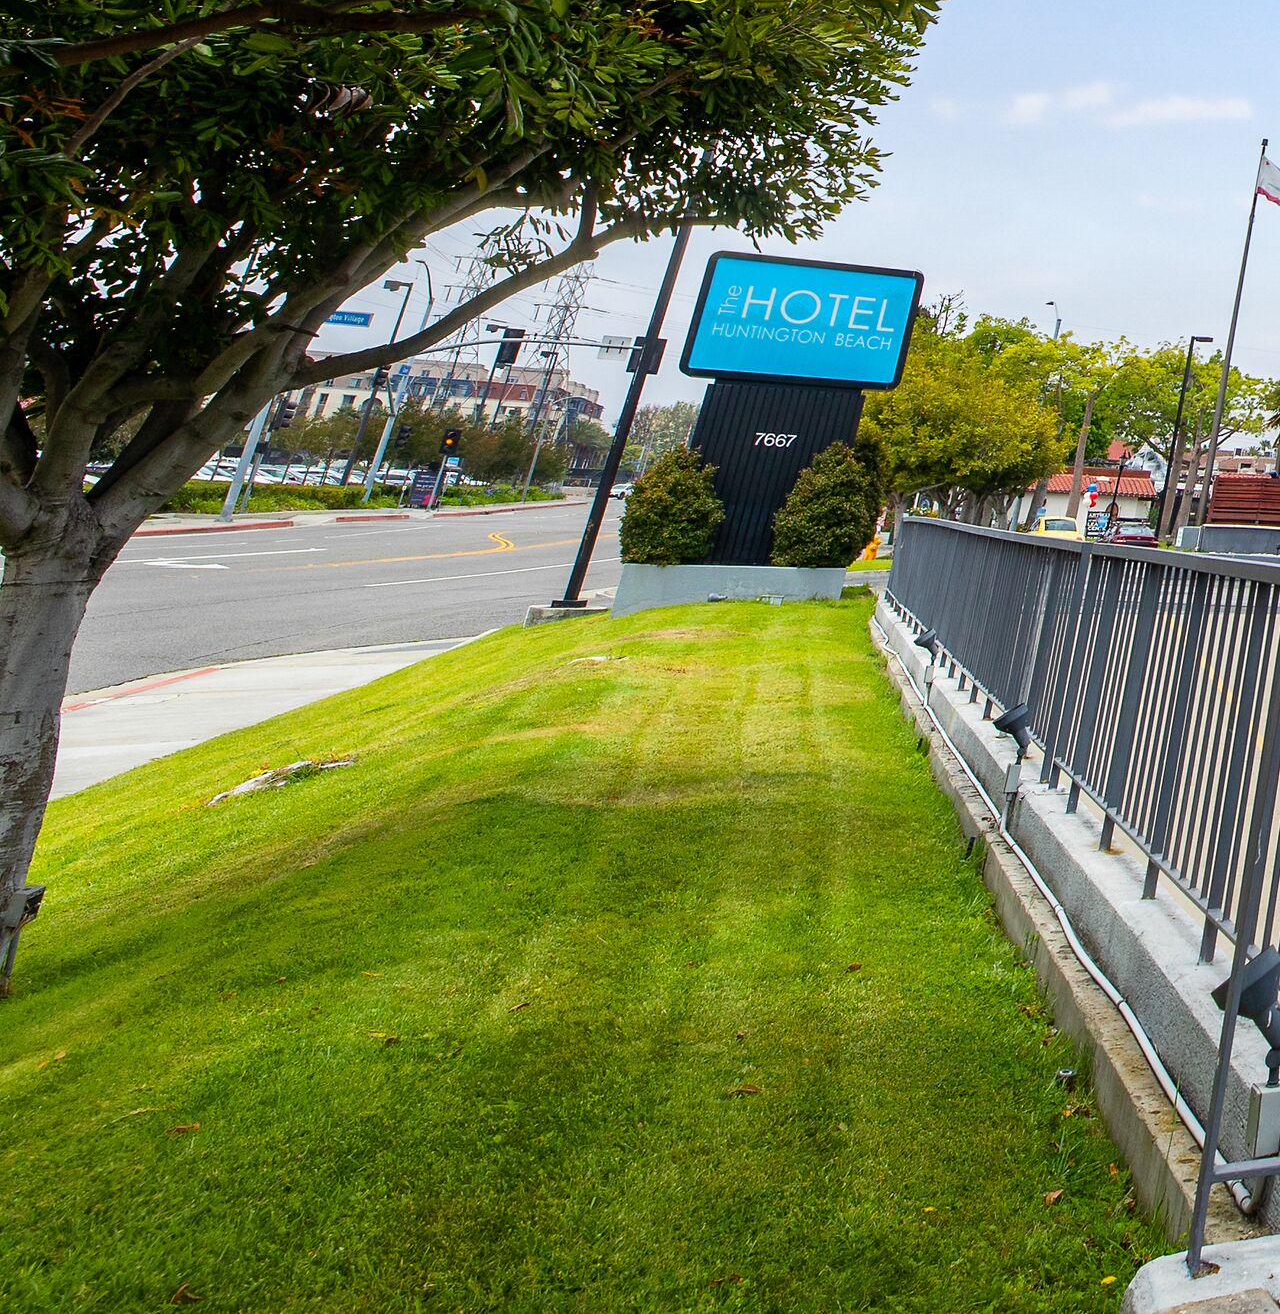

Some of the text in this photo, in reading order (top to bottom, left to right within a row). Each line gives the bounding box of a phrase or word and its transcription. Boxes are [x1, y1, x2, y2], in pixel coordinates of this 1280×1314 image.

[717, 285, 895, 333] The HOTEL
[711, 322, 893, 351] HUNTINGTON BEACH
[754, 432, 798, 448] 7667
